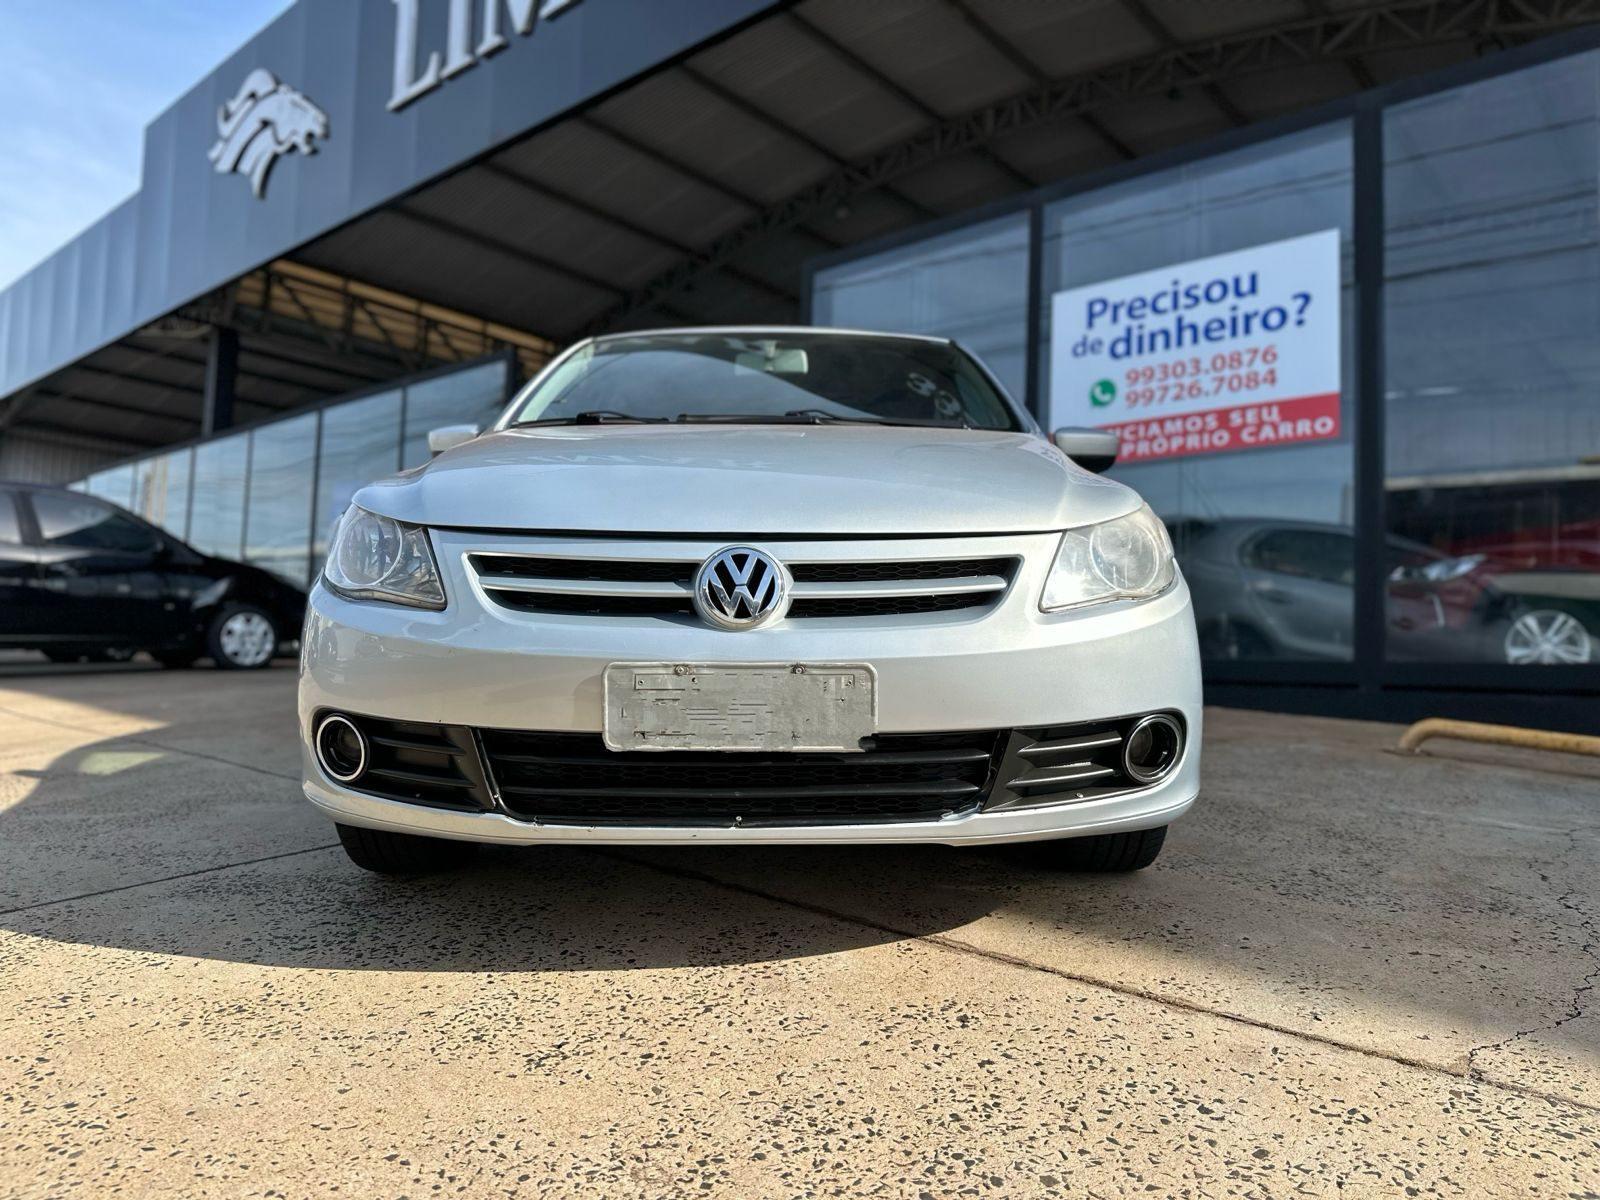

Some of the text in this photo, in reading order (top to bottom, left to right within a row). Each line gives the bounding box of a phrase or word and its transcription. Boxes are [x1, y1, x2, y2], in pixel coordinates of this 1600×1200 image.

[1086, 271, 1259, 330] Precisou
[1071, 292, 1313, 361] de dinheiro?
[1125, 344, 1278, 386] 99303.0876
[1125, 367, 1278, 408] 99726.7084
[1228, 405, 1281, 428] SEU
[1240, 415, 1335, 444] CARRO
